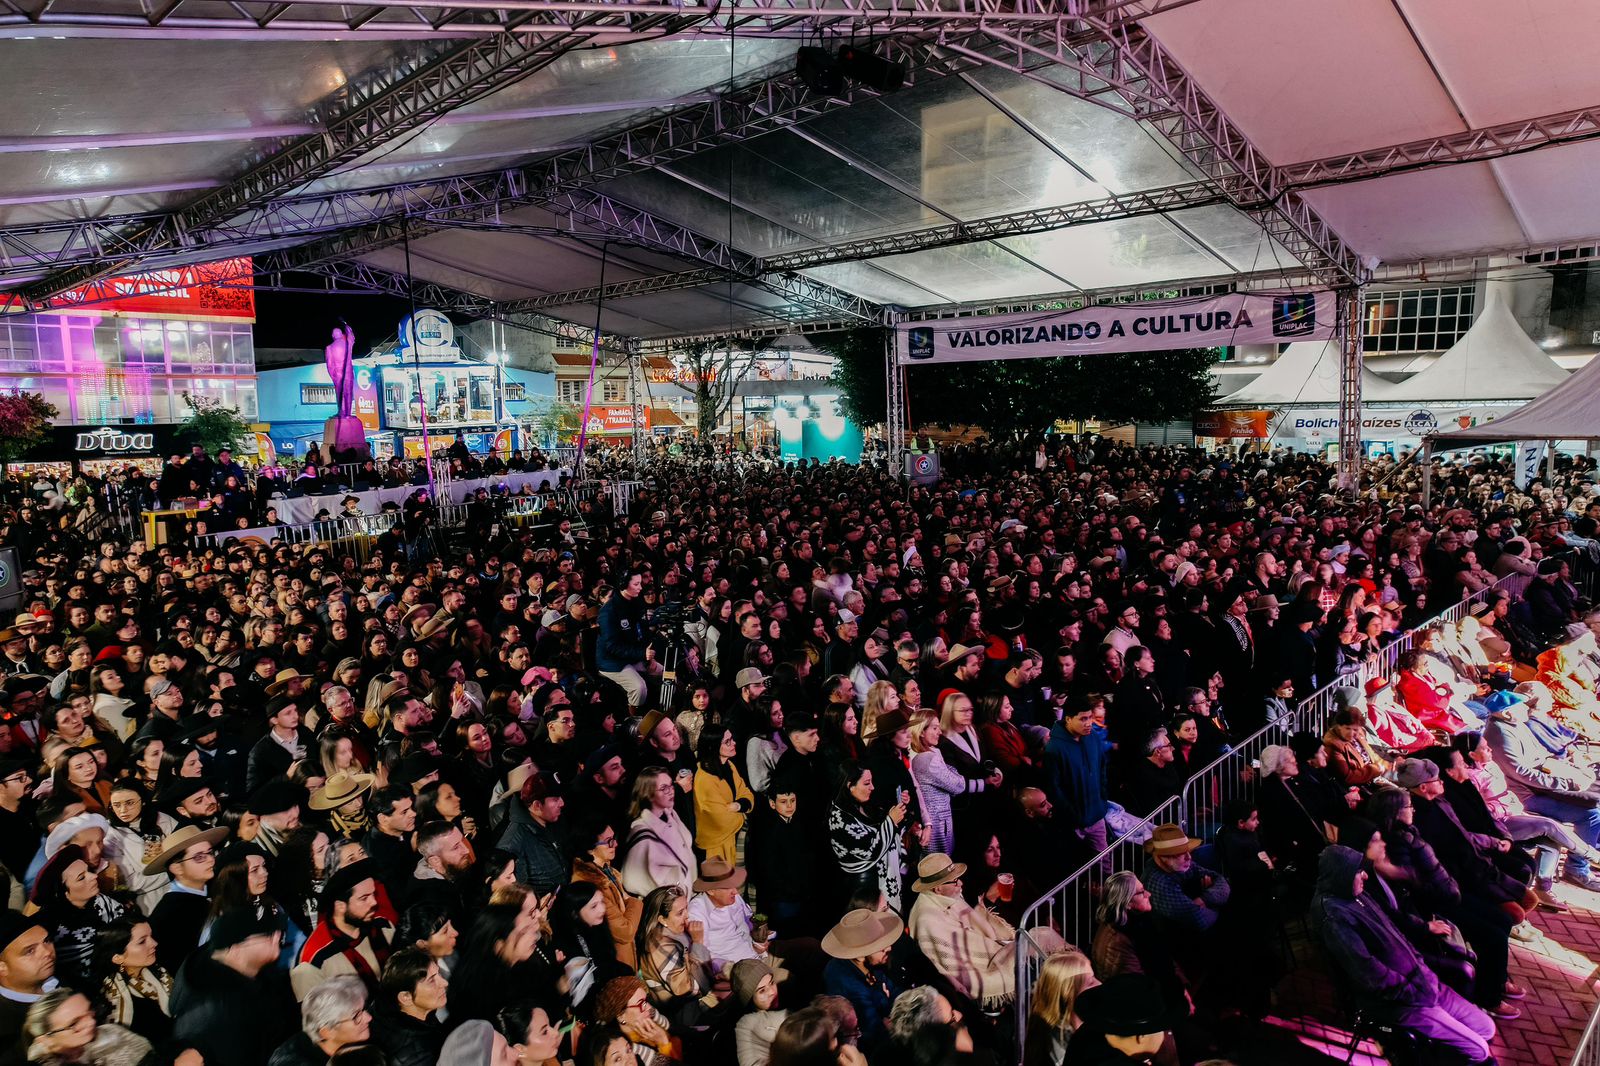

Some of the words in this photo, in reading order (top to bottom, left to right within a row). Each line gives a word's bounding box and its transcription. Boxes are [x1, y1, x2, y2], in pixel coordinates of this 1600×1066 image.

[947, 321, 1101, 349] VALORIZANDO
[1108, 320, 1126, 338] A
[1132, 309, 1254, 336] CULTURA
[1279, 322, 1308, 330] UNIPLAC
[1295, 418, 1341, 428] Bolich
[75, 427, 154, 451] Diva
